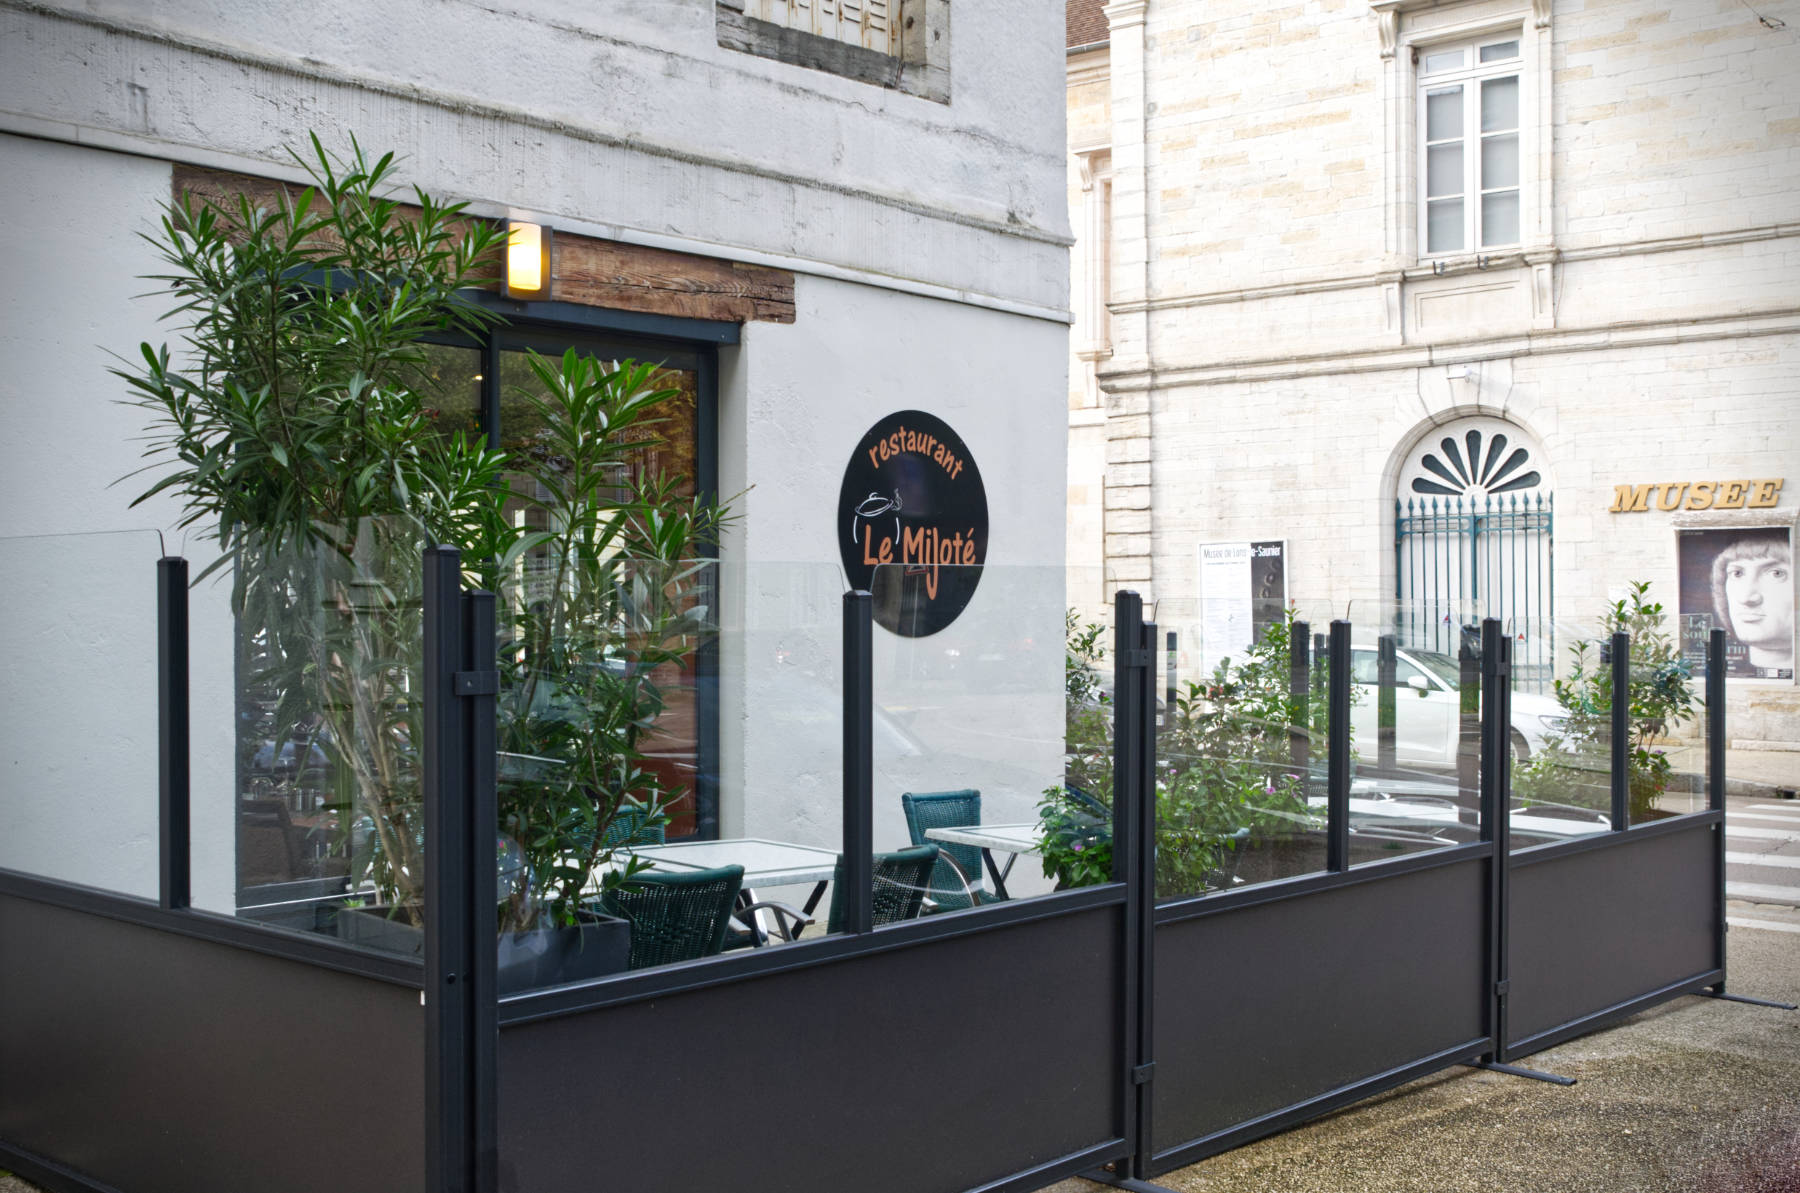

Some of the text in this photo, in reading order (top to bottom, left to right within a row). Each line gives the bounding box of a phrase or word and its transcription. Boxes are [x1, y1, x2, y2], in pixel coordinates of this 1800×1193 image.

[868, 426, 963, 480] restaurant
[1608, 478, 1784, 513] MUSEE
[864, 523, 976, 601] Le Mijoté
